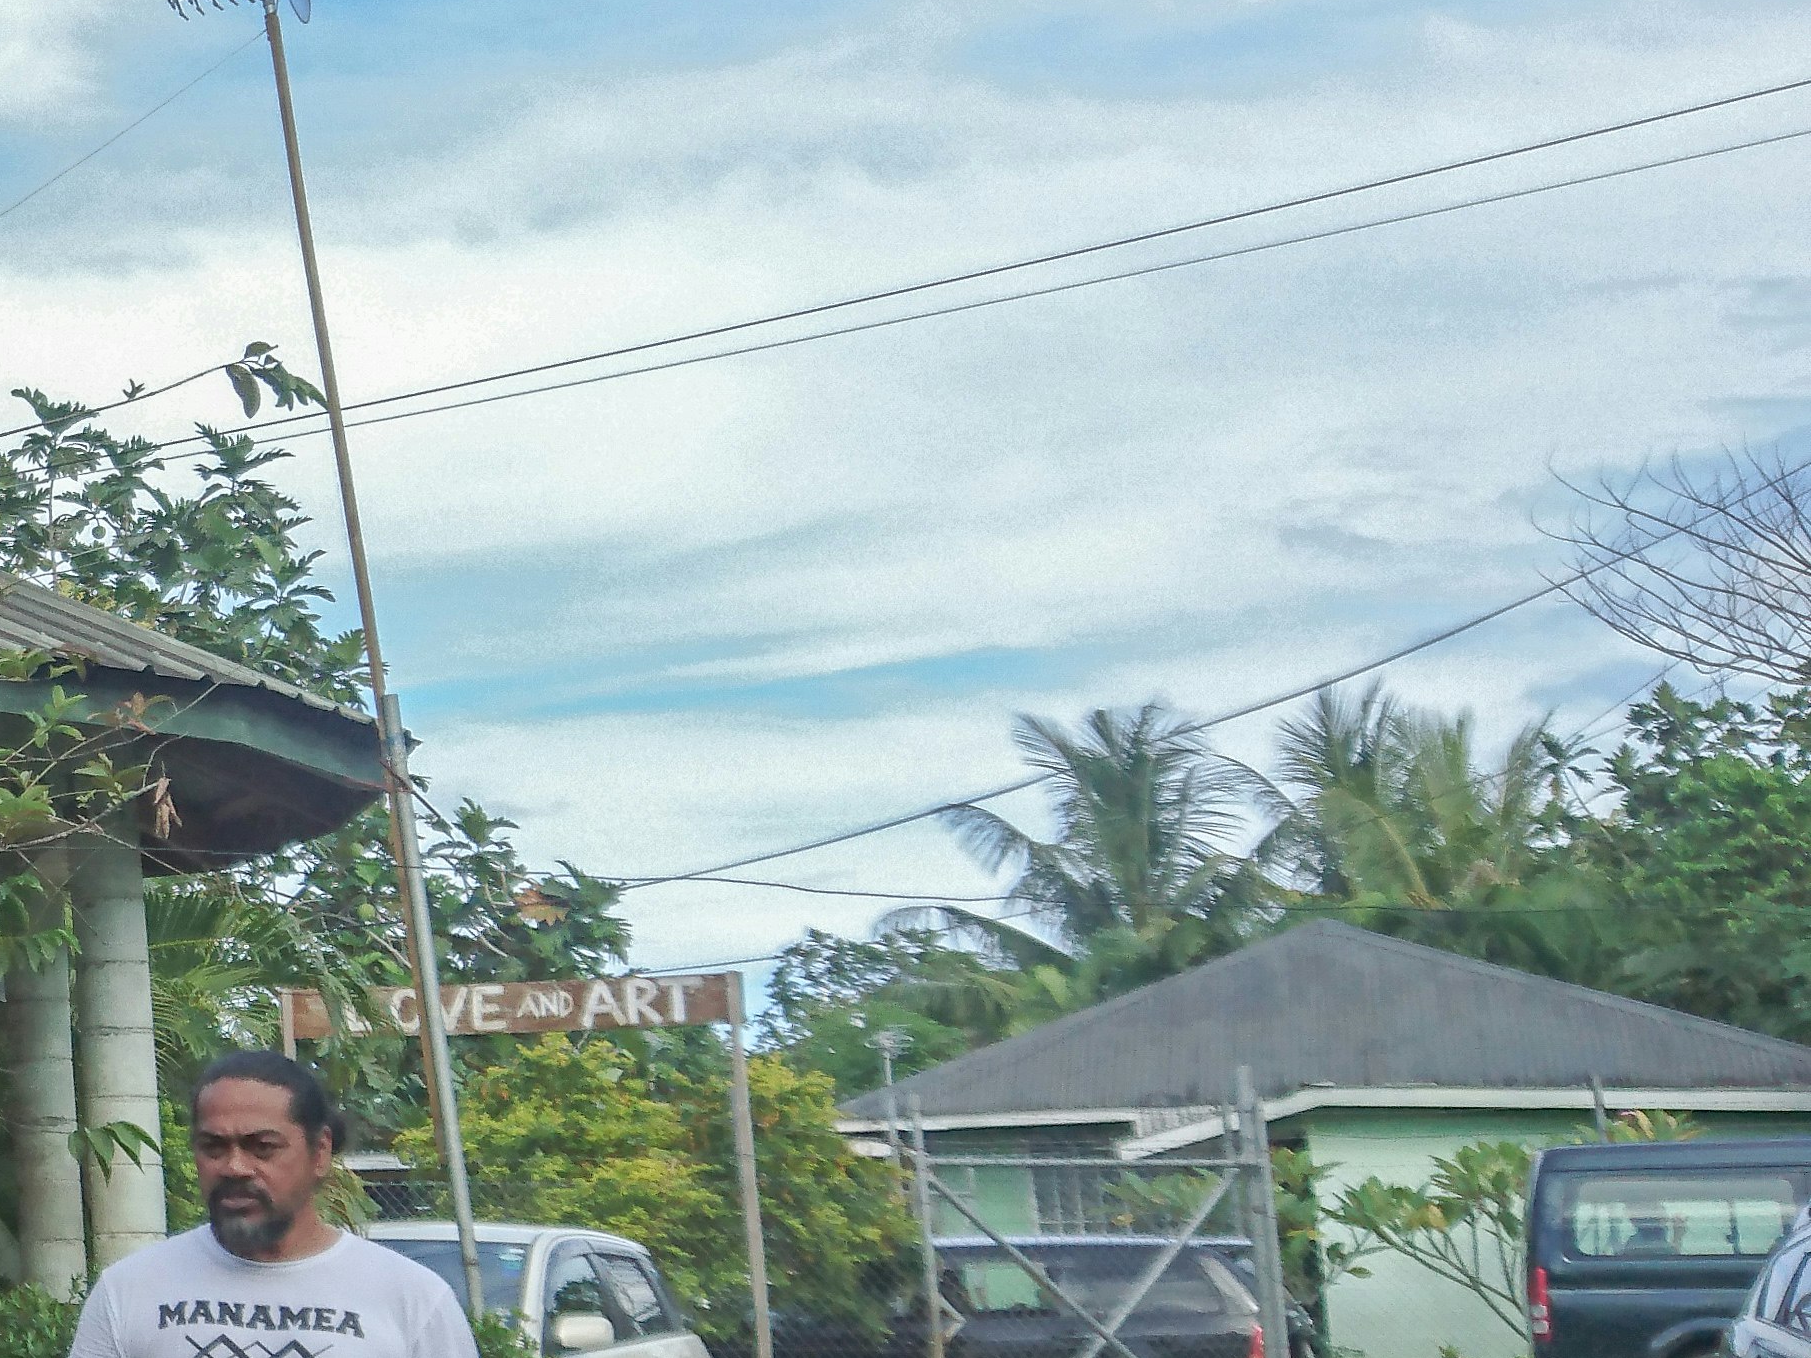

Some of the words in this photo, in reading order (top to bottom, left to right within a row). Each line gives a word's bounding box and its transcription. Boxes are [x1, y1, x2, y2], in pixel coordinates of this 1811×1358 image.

[342, 984, 508, 1035] LOVE
[518, 991, 574, 1019] AND
[582, 976, 703, 1028] ART
[158, 1300, 365, 1339] MANAMEA
